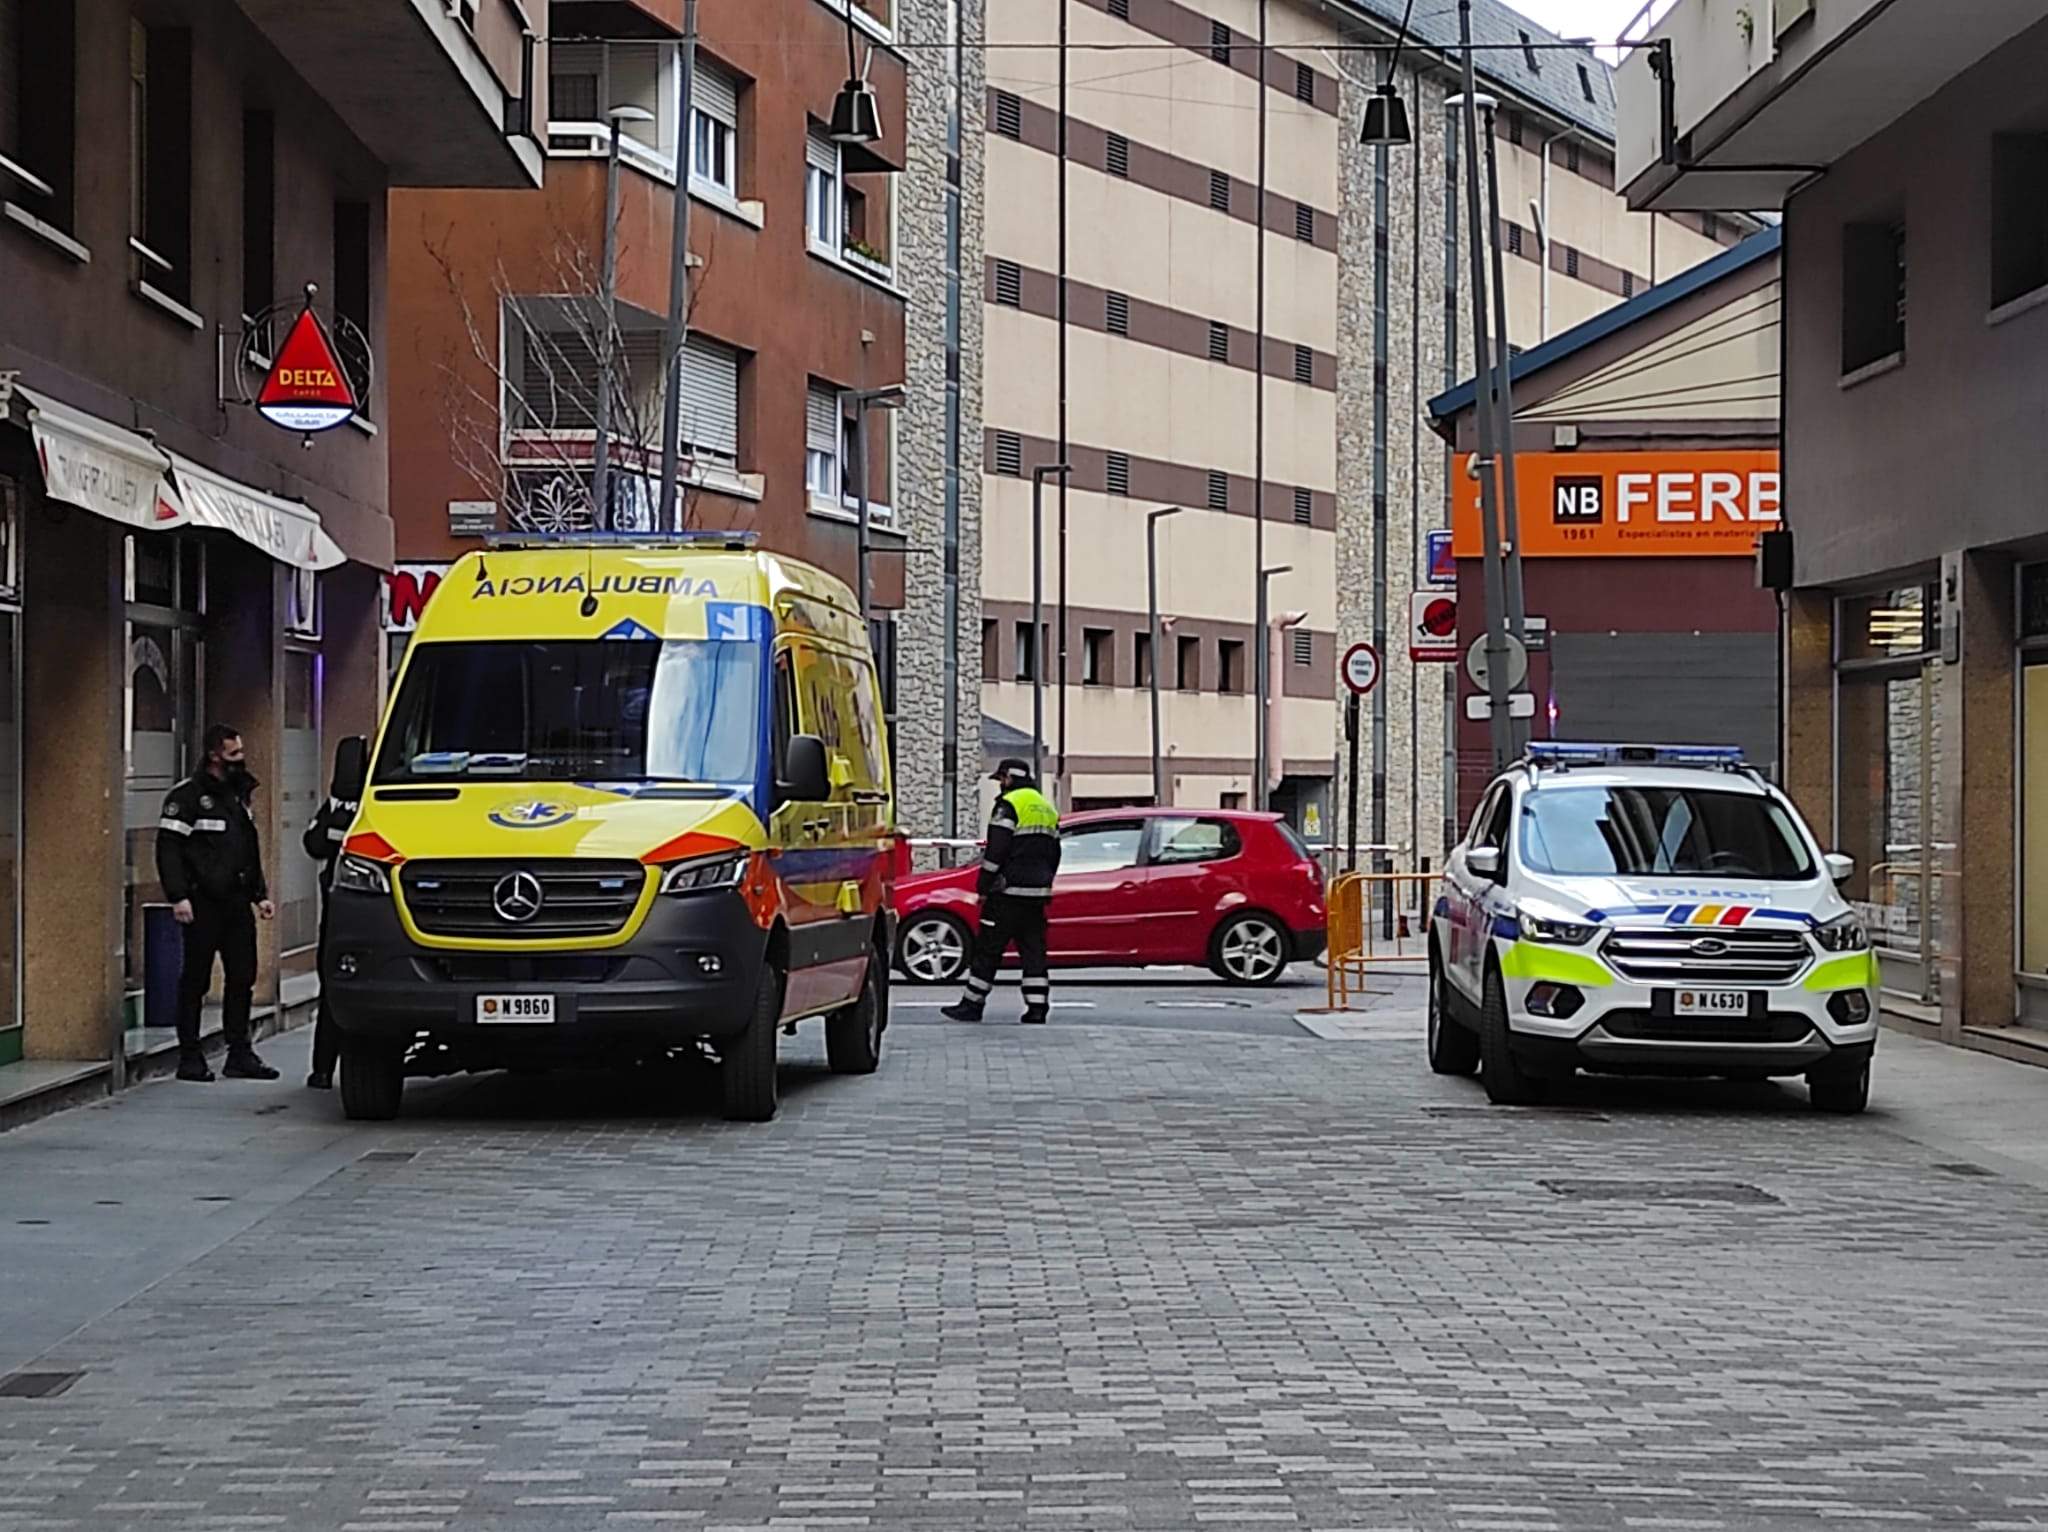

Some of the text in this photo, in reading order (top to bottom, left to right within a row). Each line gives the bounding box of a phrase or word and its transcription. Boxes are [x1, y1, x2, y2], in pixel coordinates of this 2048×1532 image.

[279, 368, 336, 387] DELTA
[1557, 486, 1600, 515] NB
[1563, 529, 1594, 540] 1961
[502, 999, 550, 1014] N 9860
[1699, 993, 1744, 1009] N 4630
